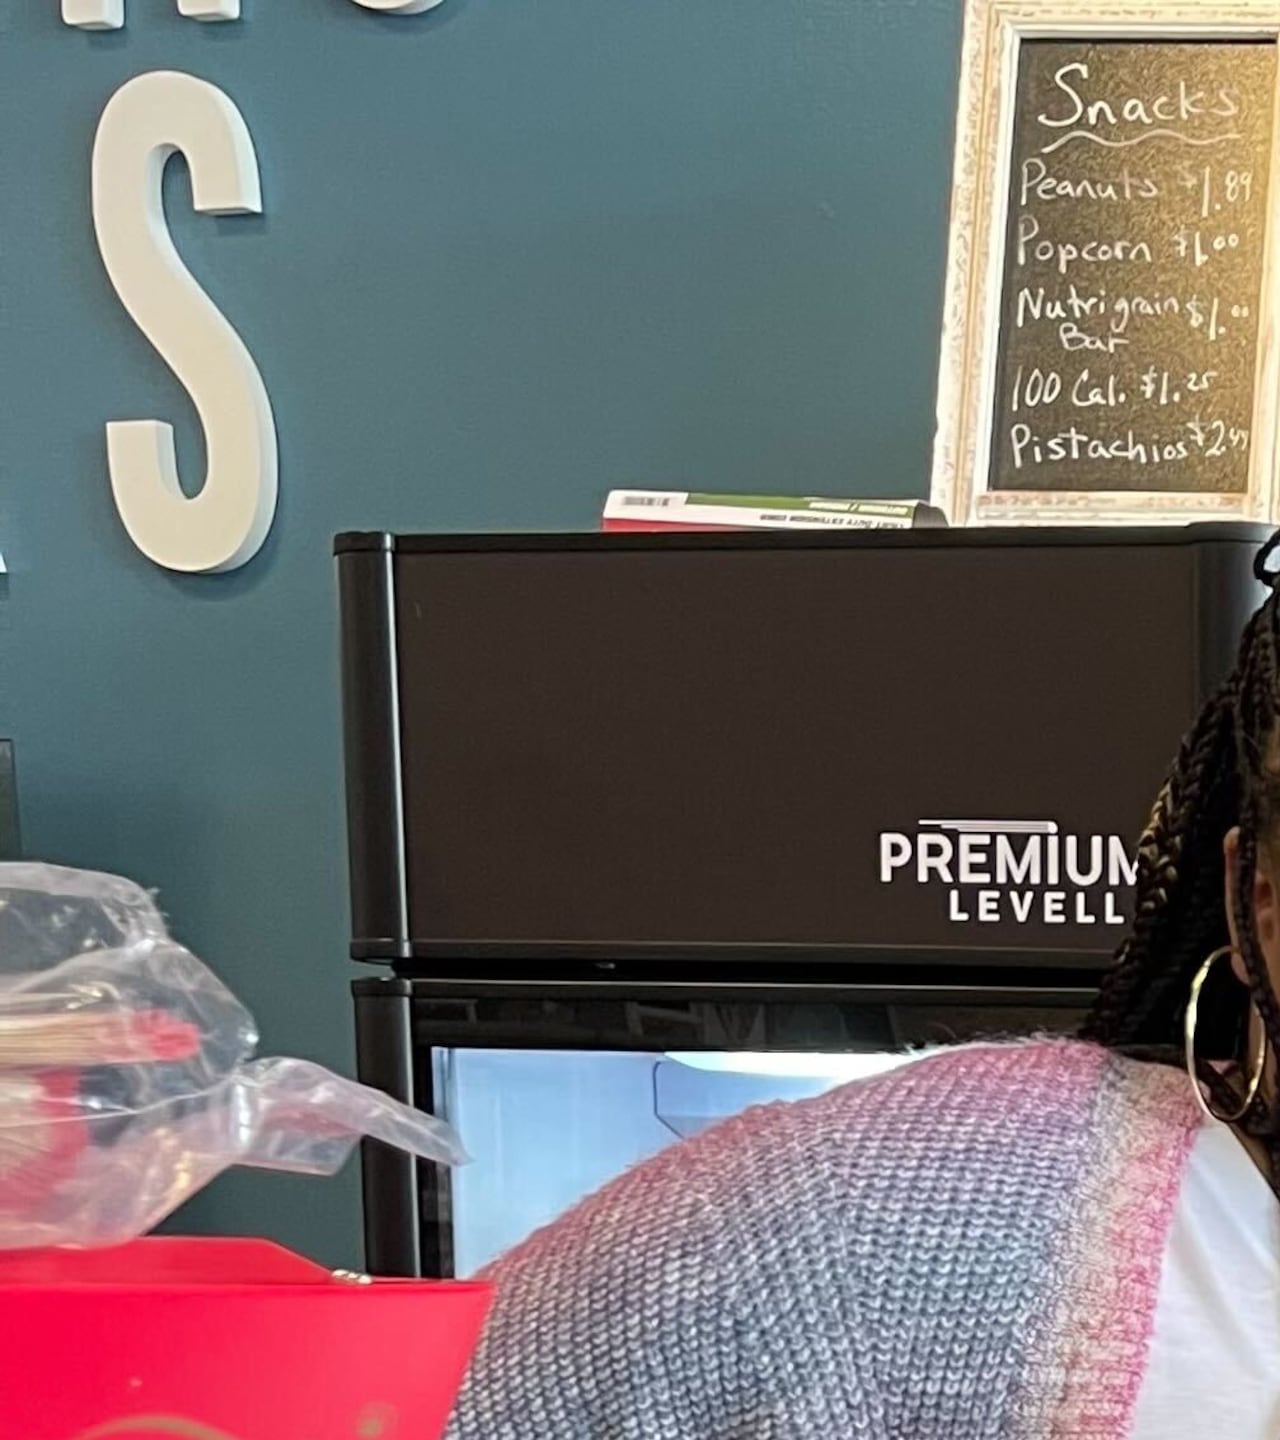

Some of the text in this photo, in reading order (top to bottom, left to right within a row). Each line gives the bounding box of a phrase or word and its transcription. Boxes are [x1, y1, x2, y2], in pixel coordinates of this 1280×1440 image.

[1038, 62, 1241, 127] Snacks
[1020, 158, 1159, 206] Peanuts
[1016, 215, 1152, 274] Popcorn
[92, 70, 279, 573] S
[1016, 285, 1181, 333] Nutrigrain
[1060, 323, 1130, 352] Bar
[1012, 369, 1062, 412] 100
[1010, 424, 1189, 469] Pistachios
[880, 833, 1139, 887] PREMIUM
[949, 889, 1125, 925] LEVELL
